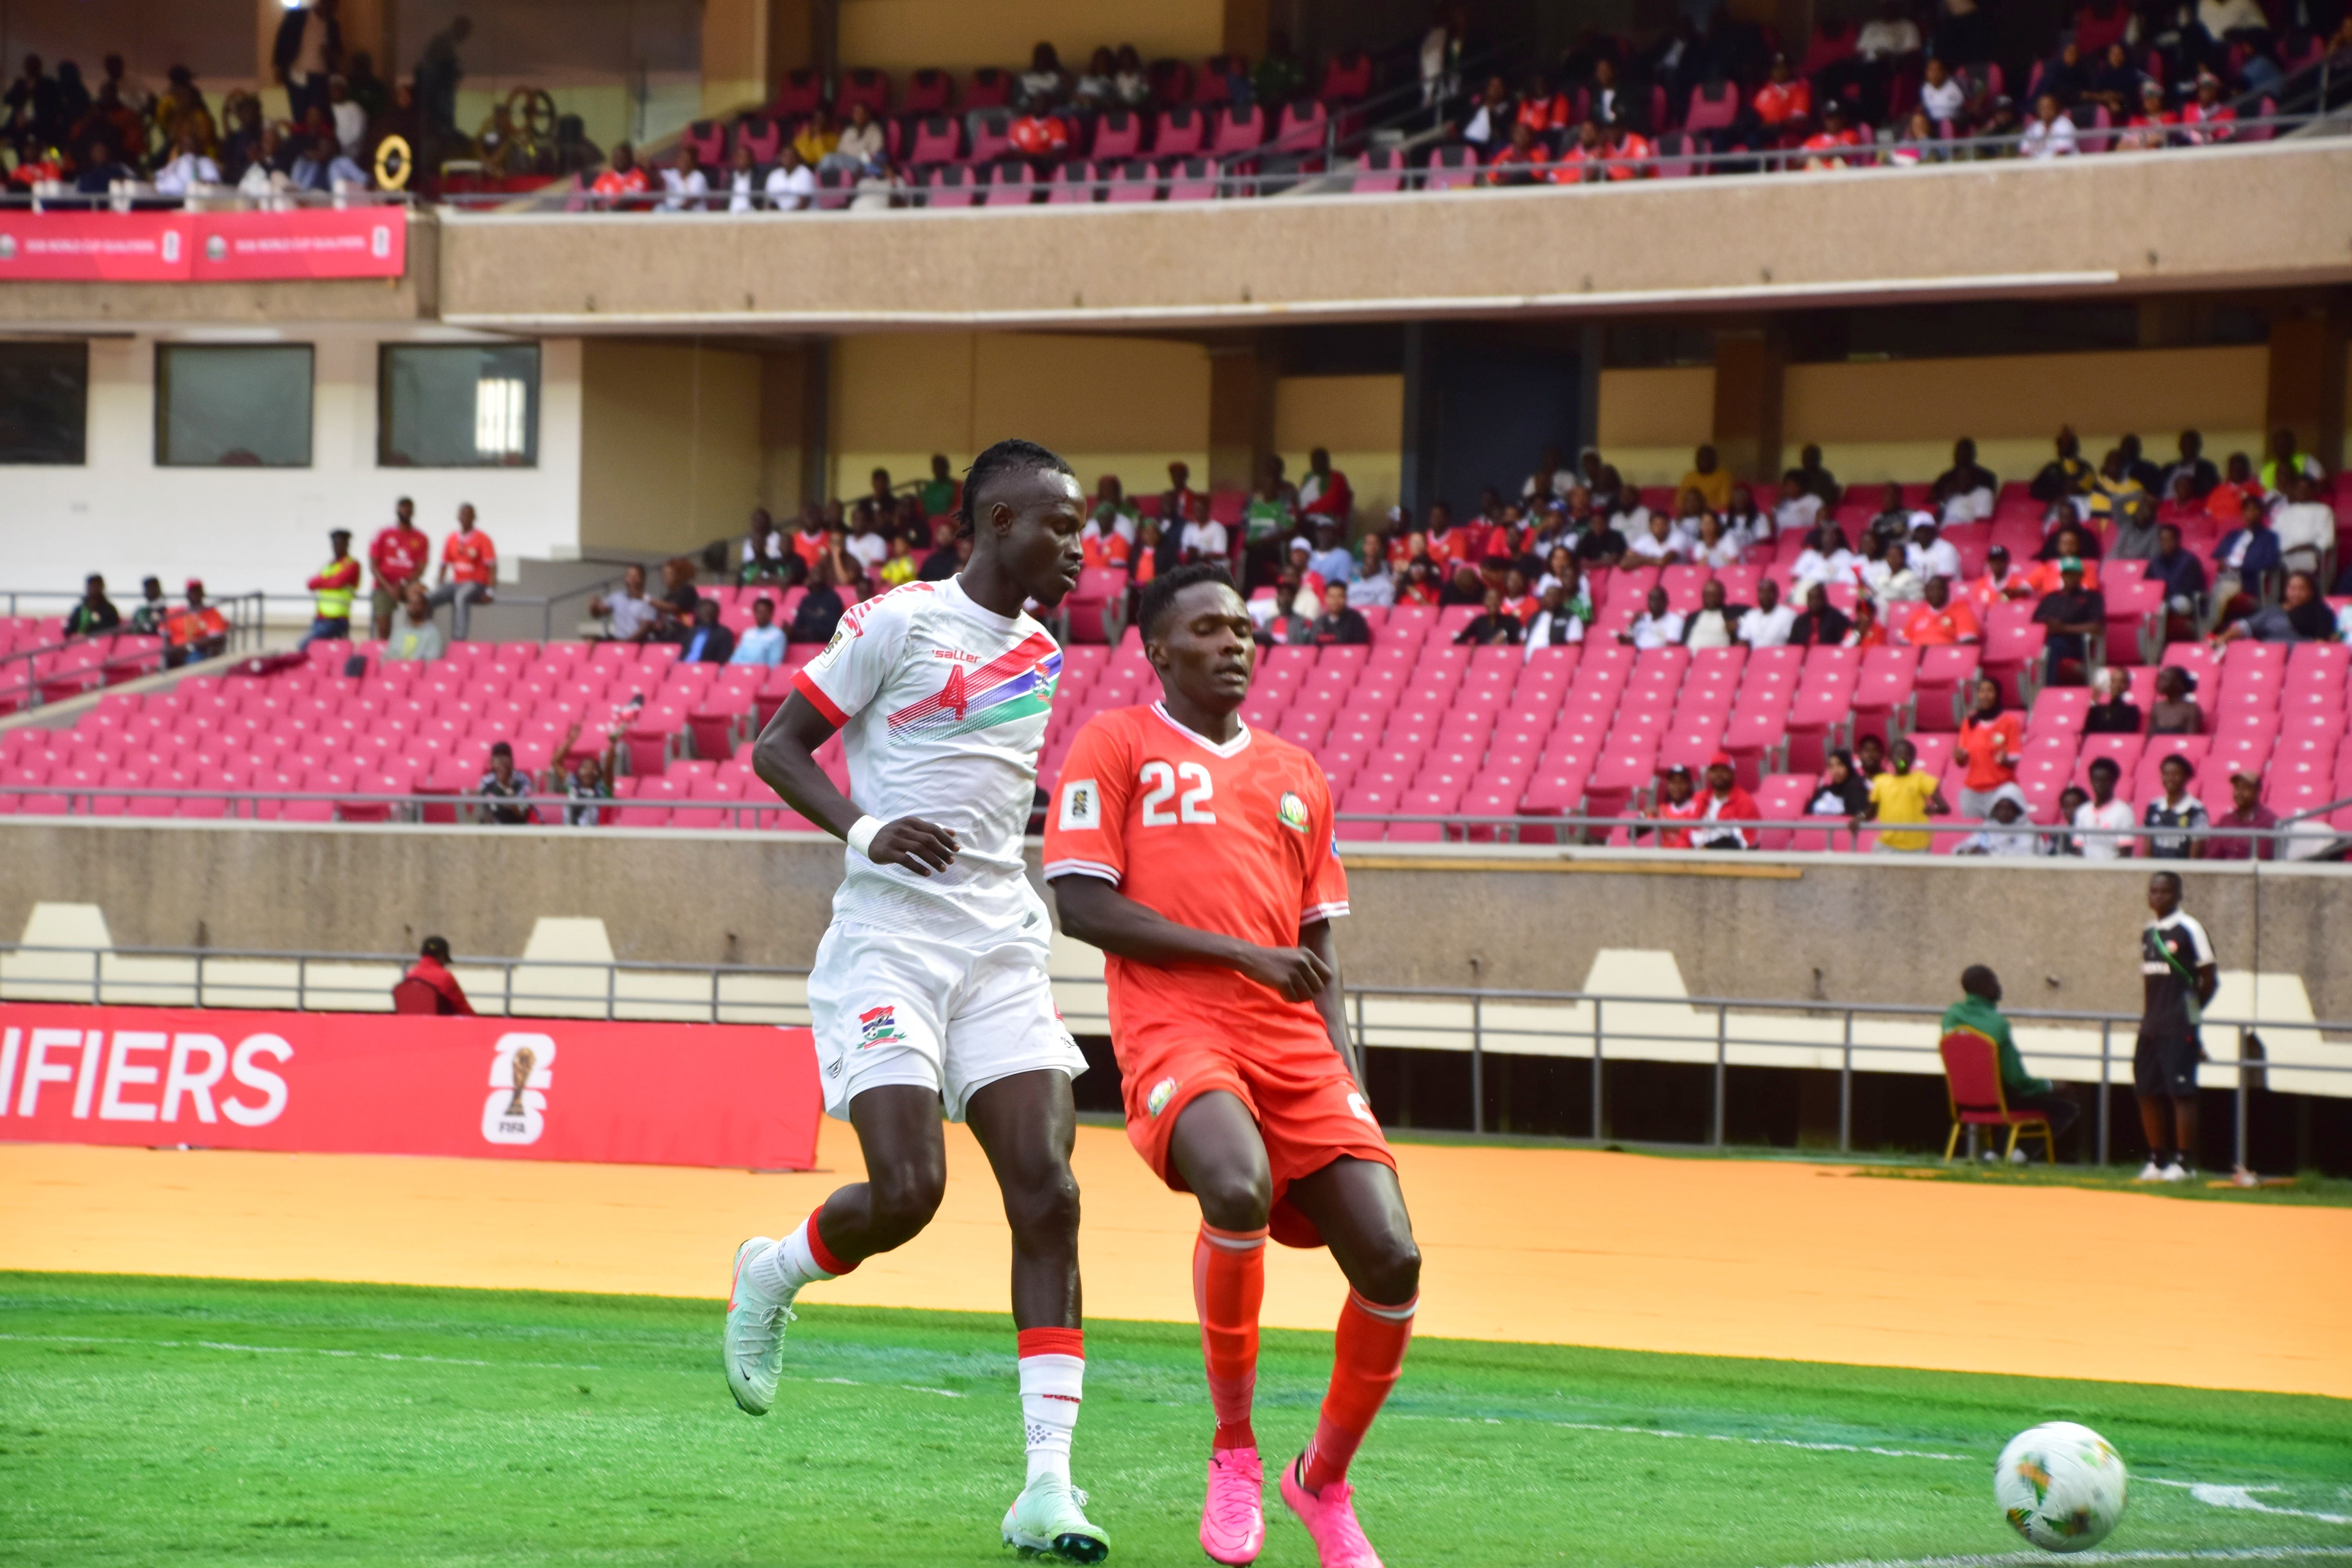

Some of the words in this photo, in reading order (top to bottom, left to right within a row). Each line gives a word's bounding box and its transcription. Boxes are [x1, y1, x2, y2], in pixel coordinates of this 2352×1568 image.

[939, 665, 967, 720] 4
[1139, 761, 1217, 827] 22
[0, 1027, 294, 1126] IFIERS
[499, 1122, 526, 1133] FIFA
